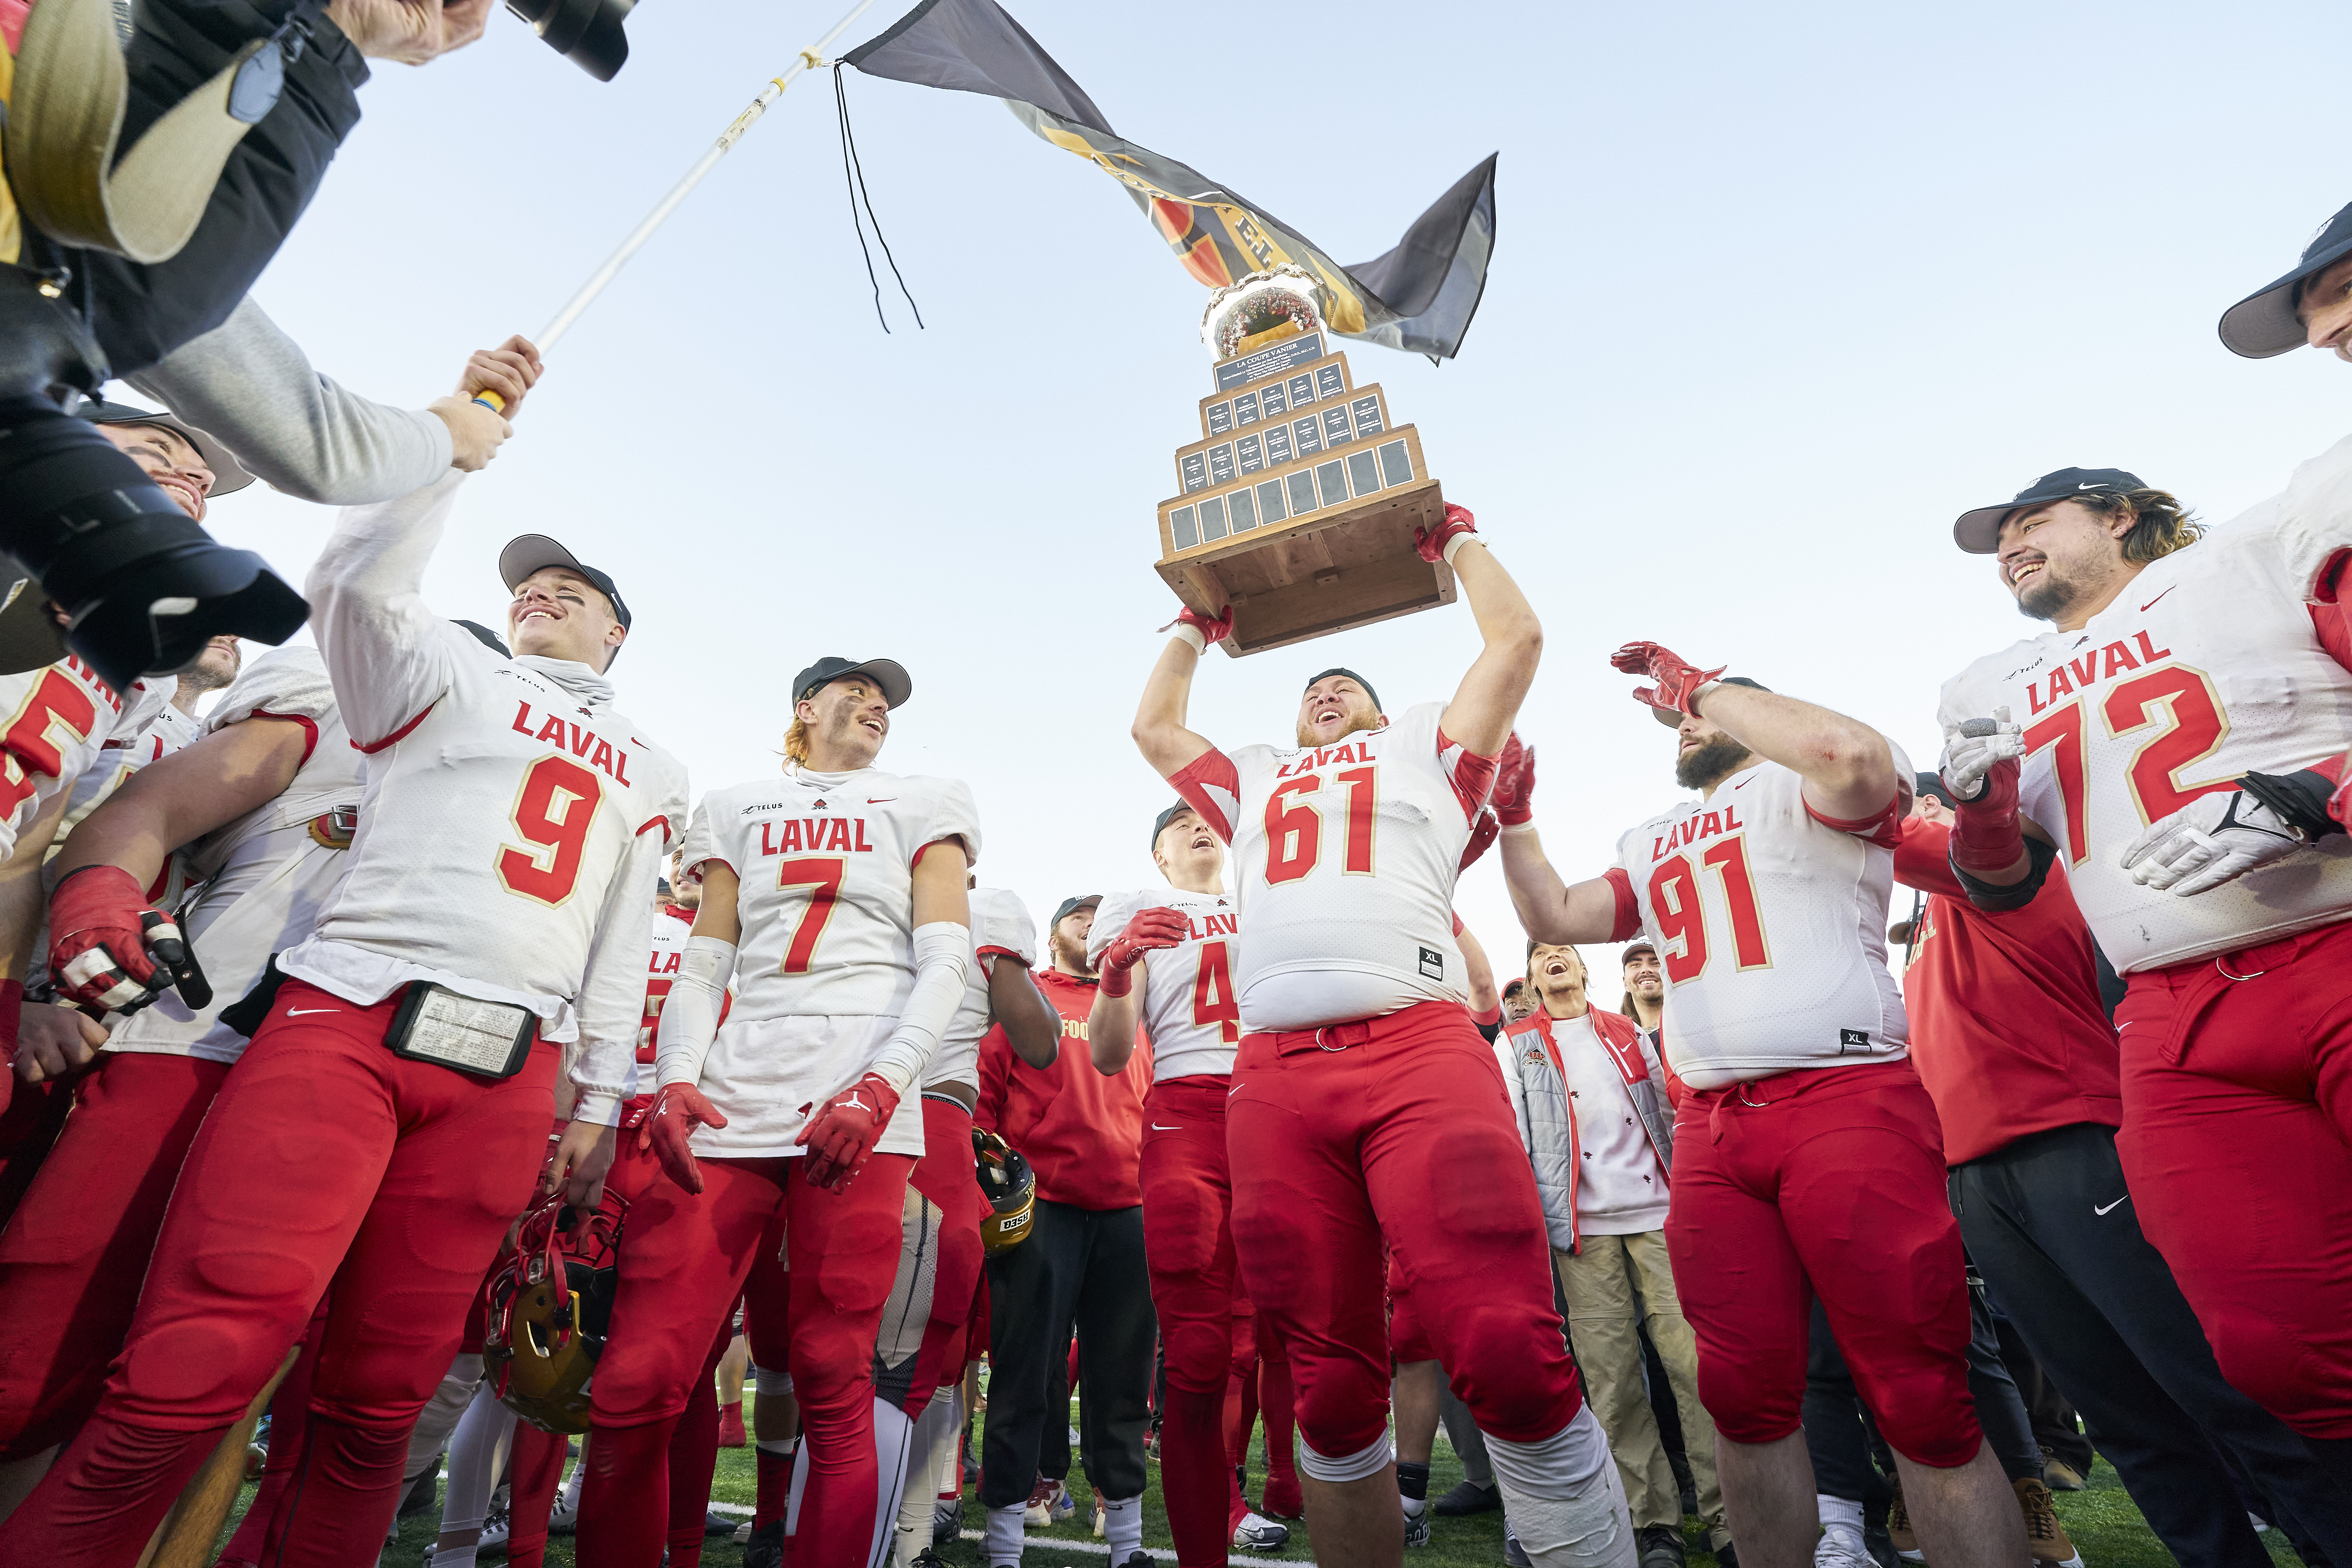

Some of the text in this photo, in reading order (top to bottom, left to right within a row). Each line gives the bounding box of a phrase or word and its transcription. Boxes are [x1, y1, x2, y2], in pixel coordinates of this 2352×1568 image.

[1247, 352, 1270, 364] COUPE
[1270, 343, 1298, 356] VANIER
[516, 675, 545, 692] TELUS
[2021, 656, 2043, 673] TELUS
[2026, 630, 2171, 716] LAVAL
[512, 700, 630, 788] LAVAL
[1277, 742, 1376, 779] LAVAL
[2022, 661, 2249, 871] 72
[757, 803, 782, 811] TELUS
[493, 751, 605, 909] 9
[762, 818, 873, 856] LAVAL
[1263, 764, 1379, 889] 61
[1652, 805, 1742, 862] LAVAL
[776, 855, 848, 975] 7
[1188, 913, 1238, 940] LAV
[1647, 832, 1774, 988] 91
[1426, 951, 1438, 963] XL
[1191, 938, 1241, 1046] 4
[1848, 1033, 1862, 1043] XL
[1004, 1212, 1029, 1229] RSEQ
